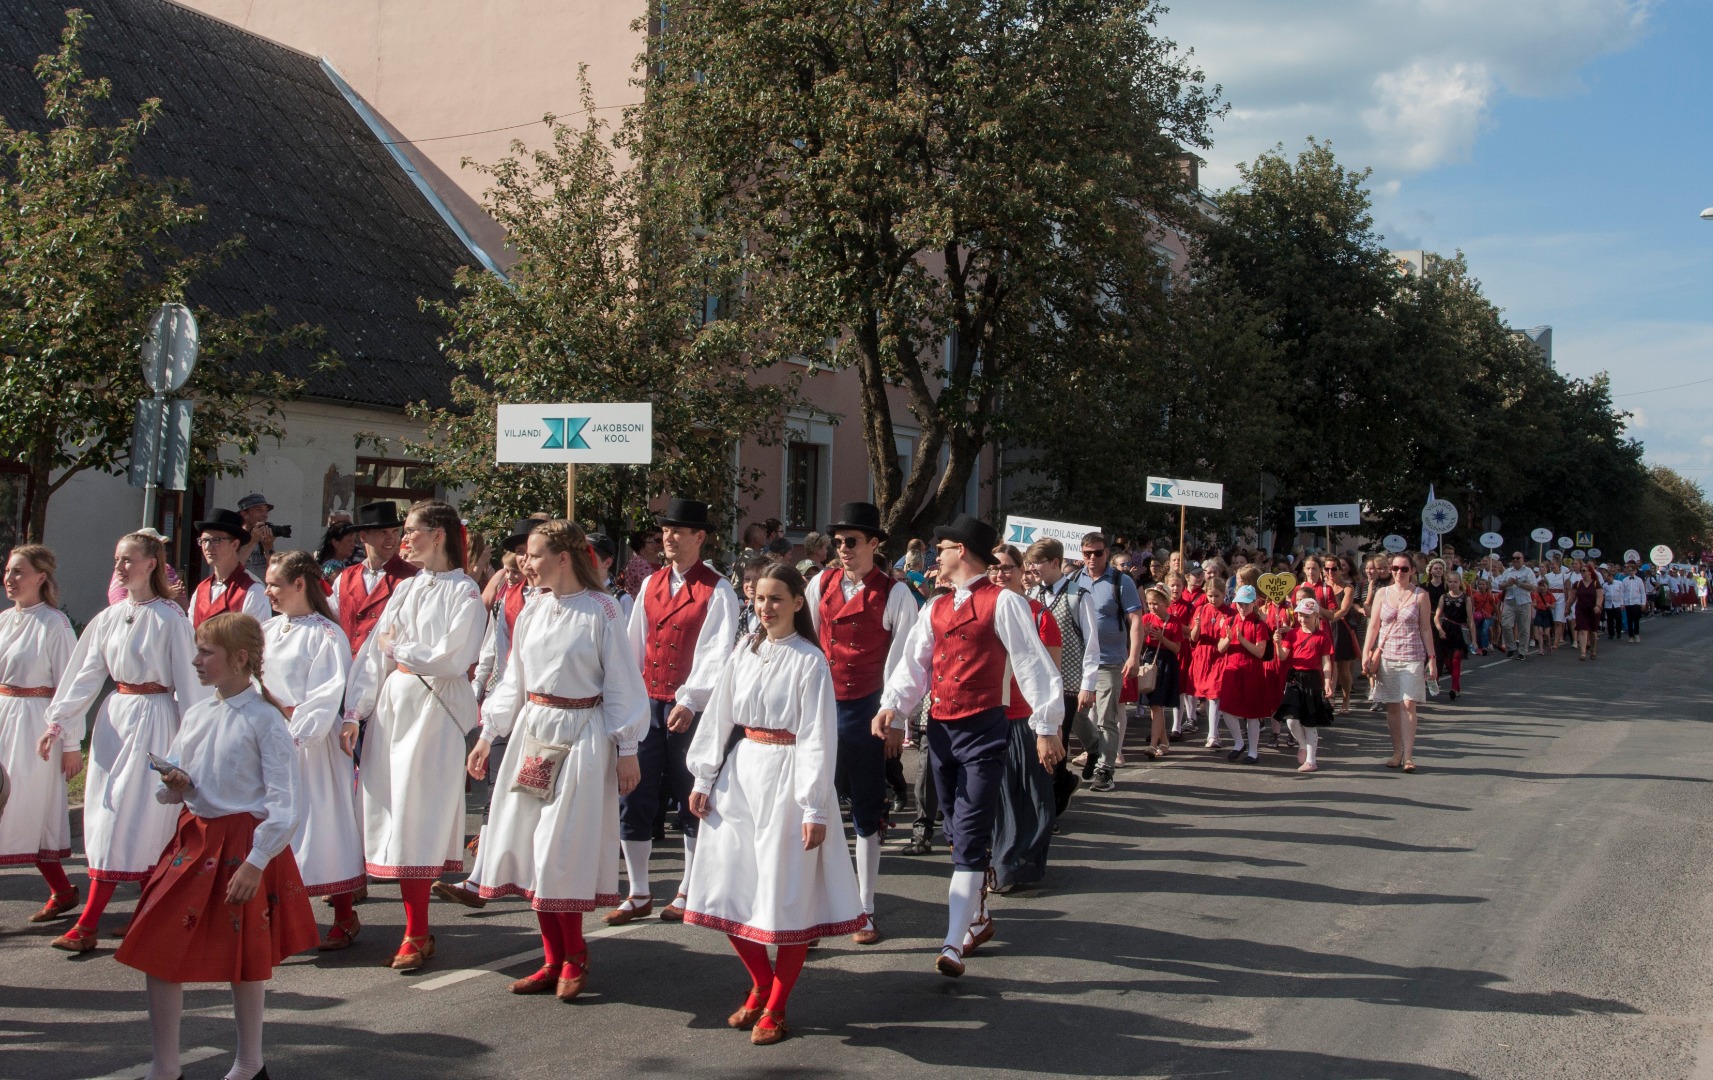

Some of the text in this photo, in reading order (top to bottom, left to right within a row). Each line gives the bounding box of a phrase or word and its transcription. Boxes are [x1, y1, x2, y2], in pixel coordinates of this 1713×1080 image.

[591, 423, 645, 433] JAKOBSONI
[504, 429, 542, 438] VILJANDI
[604, 434, 630, 443] KOOL
[1177, 488, 1220, 500] LASTEKOOR
[1327, 511, 1350, 519] HEBE
[1041, 527, 1086, 541] MUDILASKO
